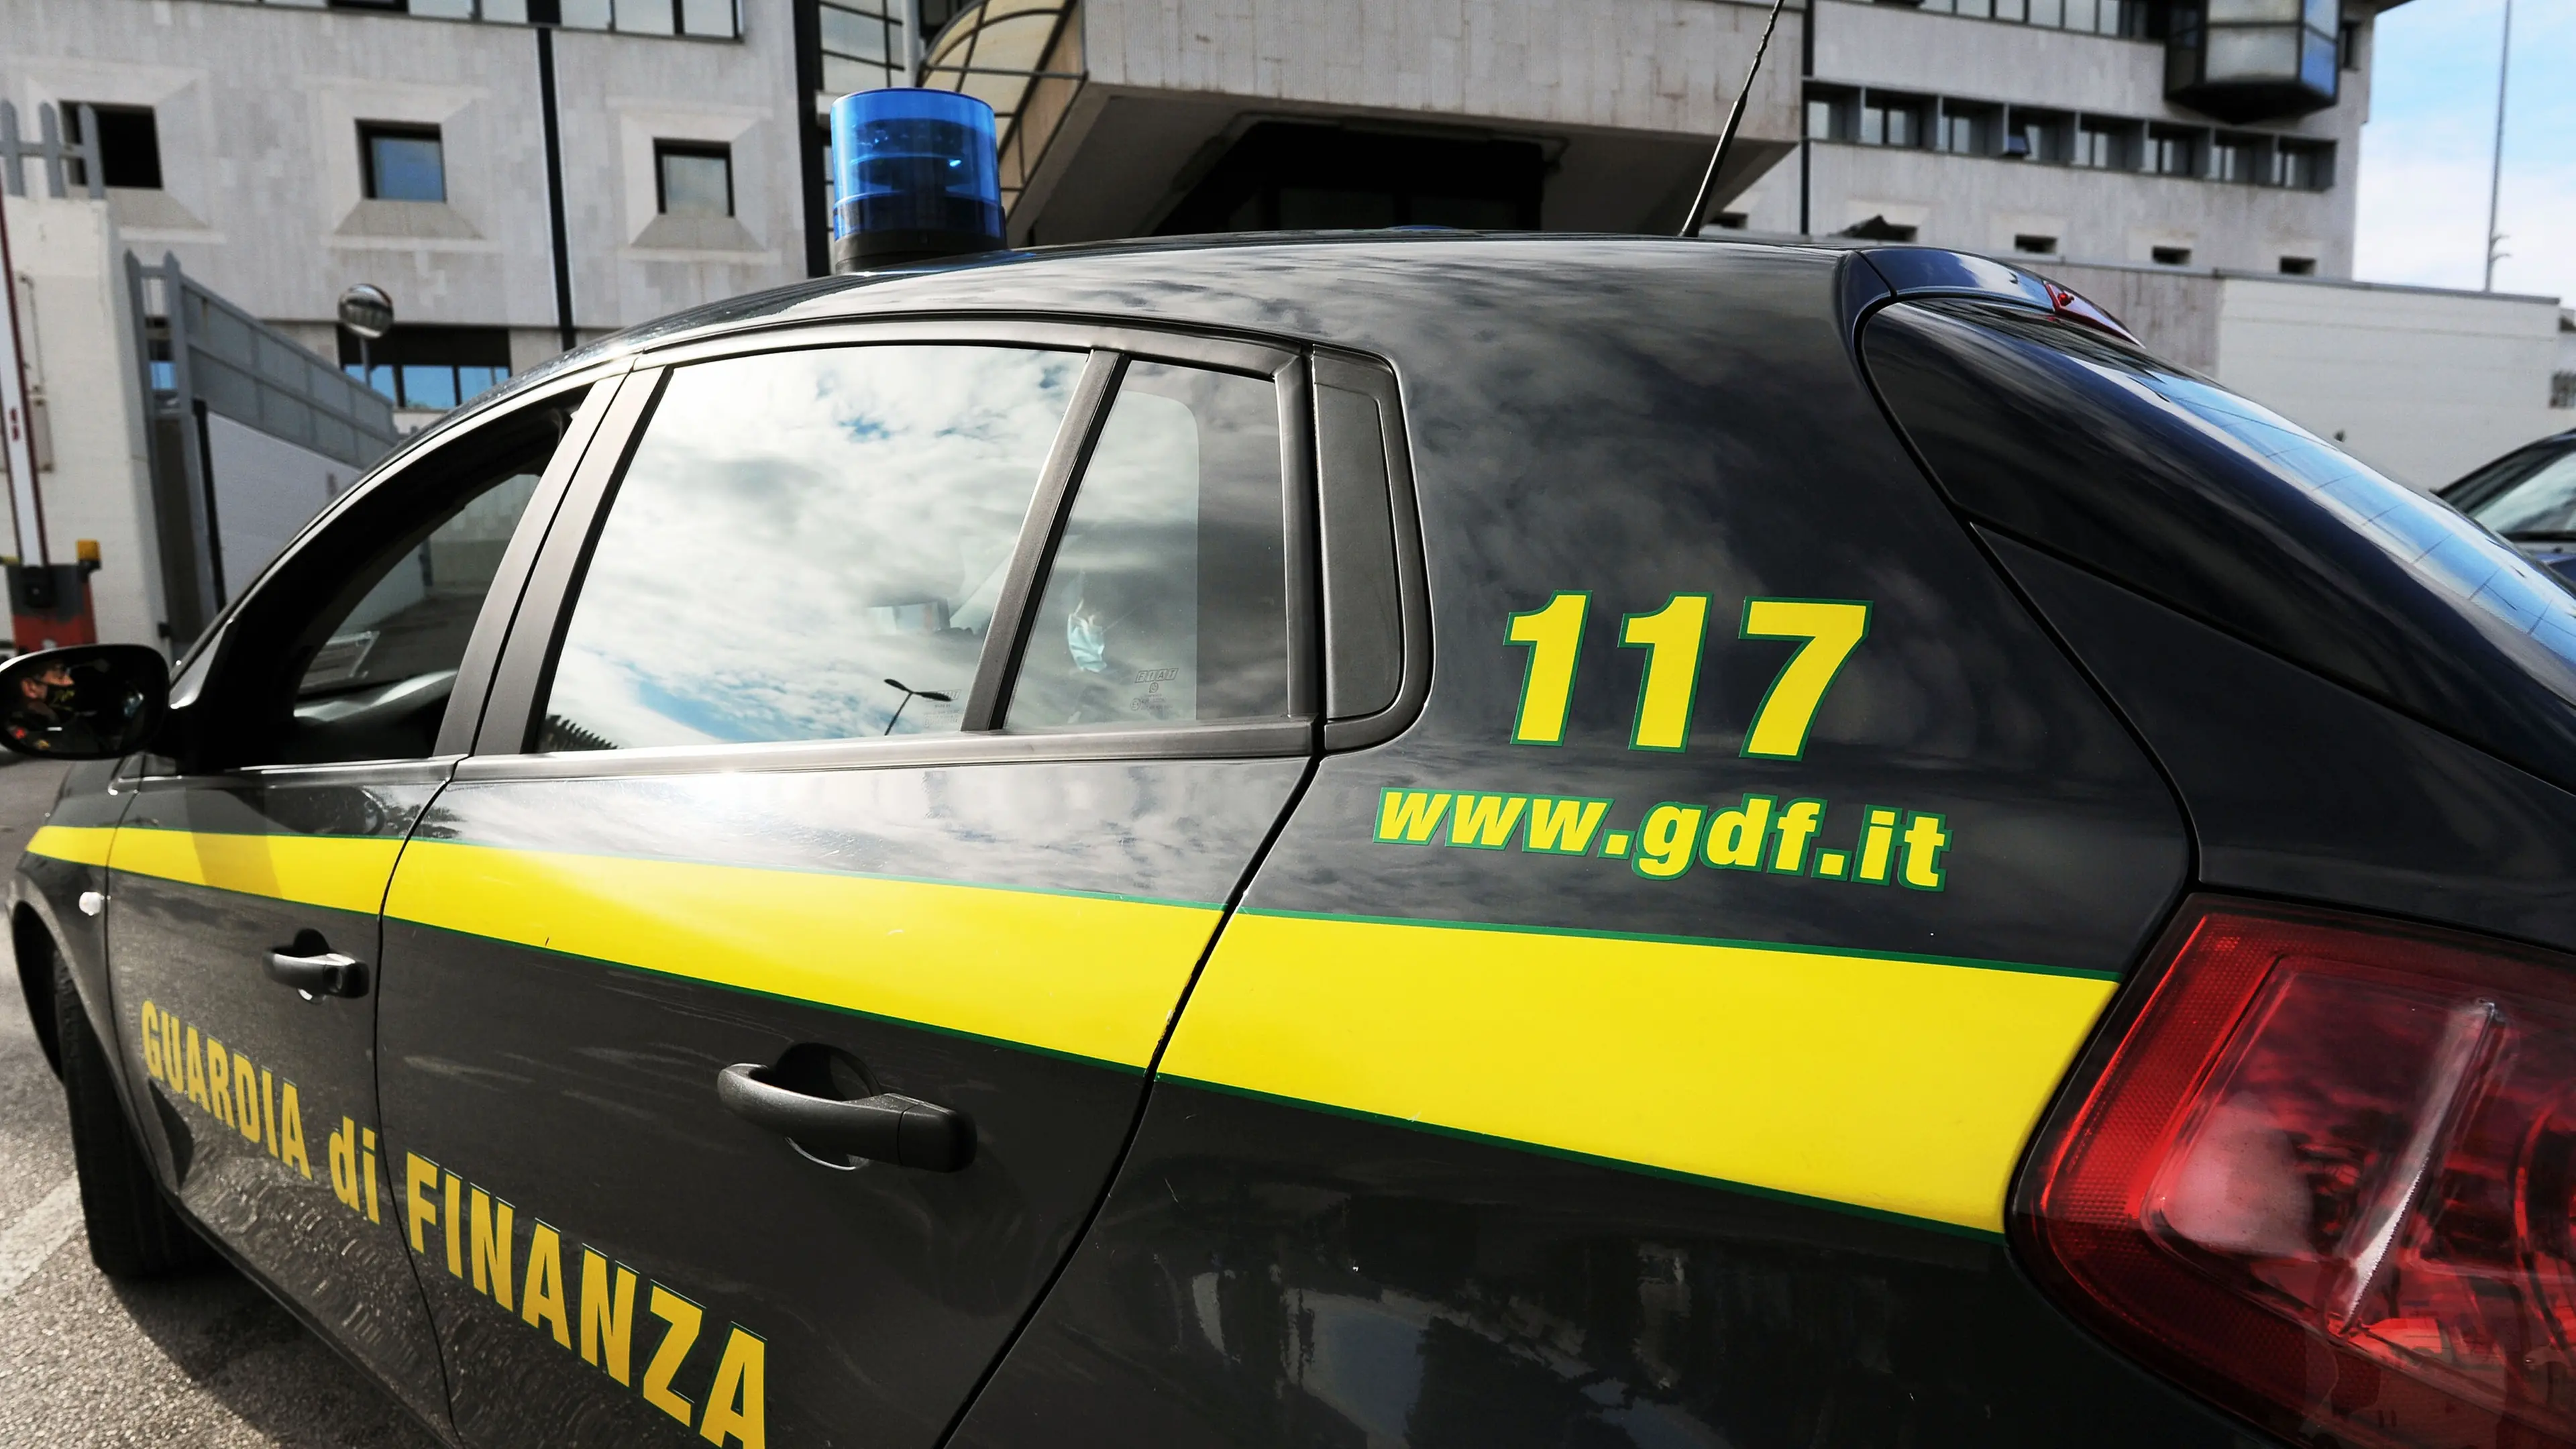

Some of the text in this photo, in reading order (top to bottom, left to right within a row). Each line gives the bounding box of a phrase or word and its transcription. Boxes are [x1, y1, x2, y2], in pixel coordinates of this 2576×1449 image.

[1135, 667, 1179, 683] FIAT
[1505, 590, 1873, 760] 117
[1375, 788, 1952, 891] www.gdf.it
[142, 1001, 767, 1449] GUARDIA di FINANZA
